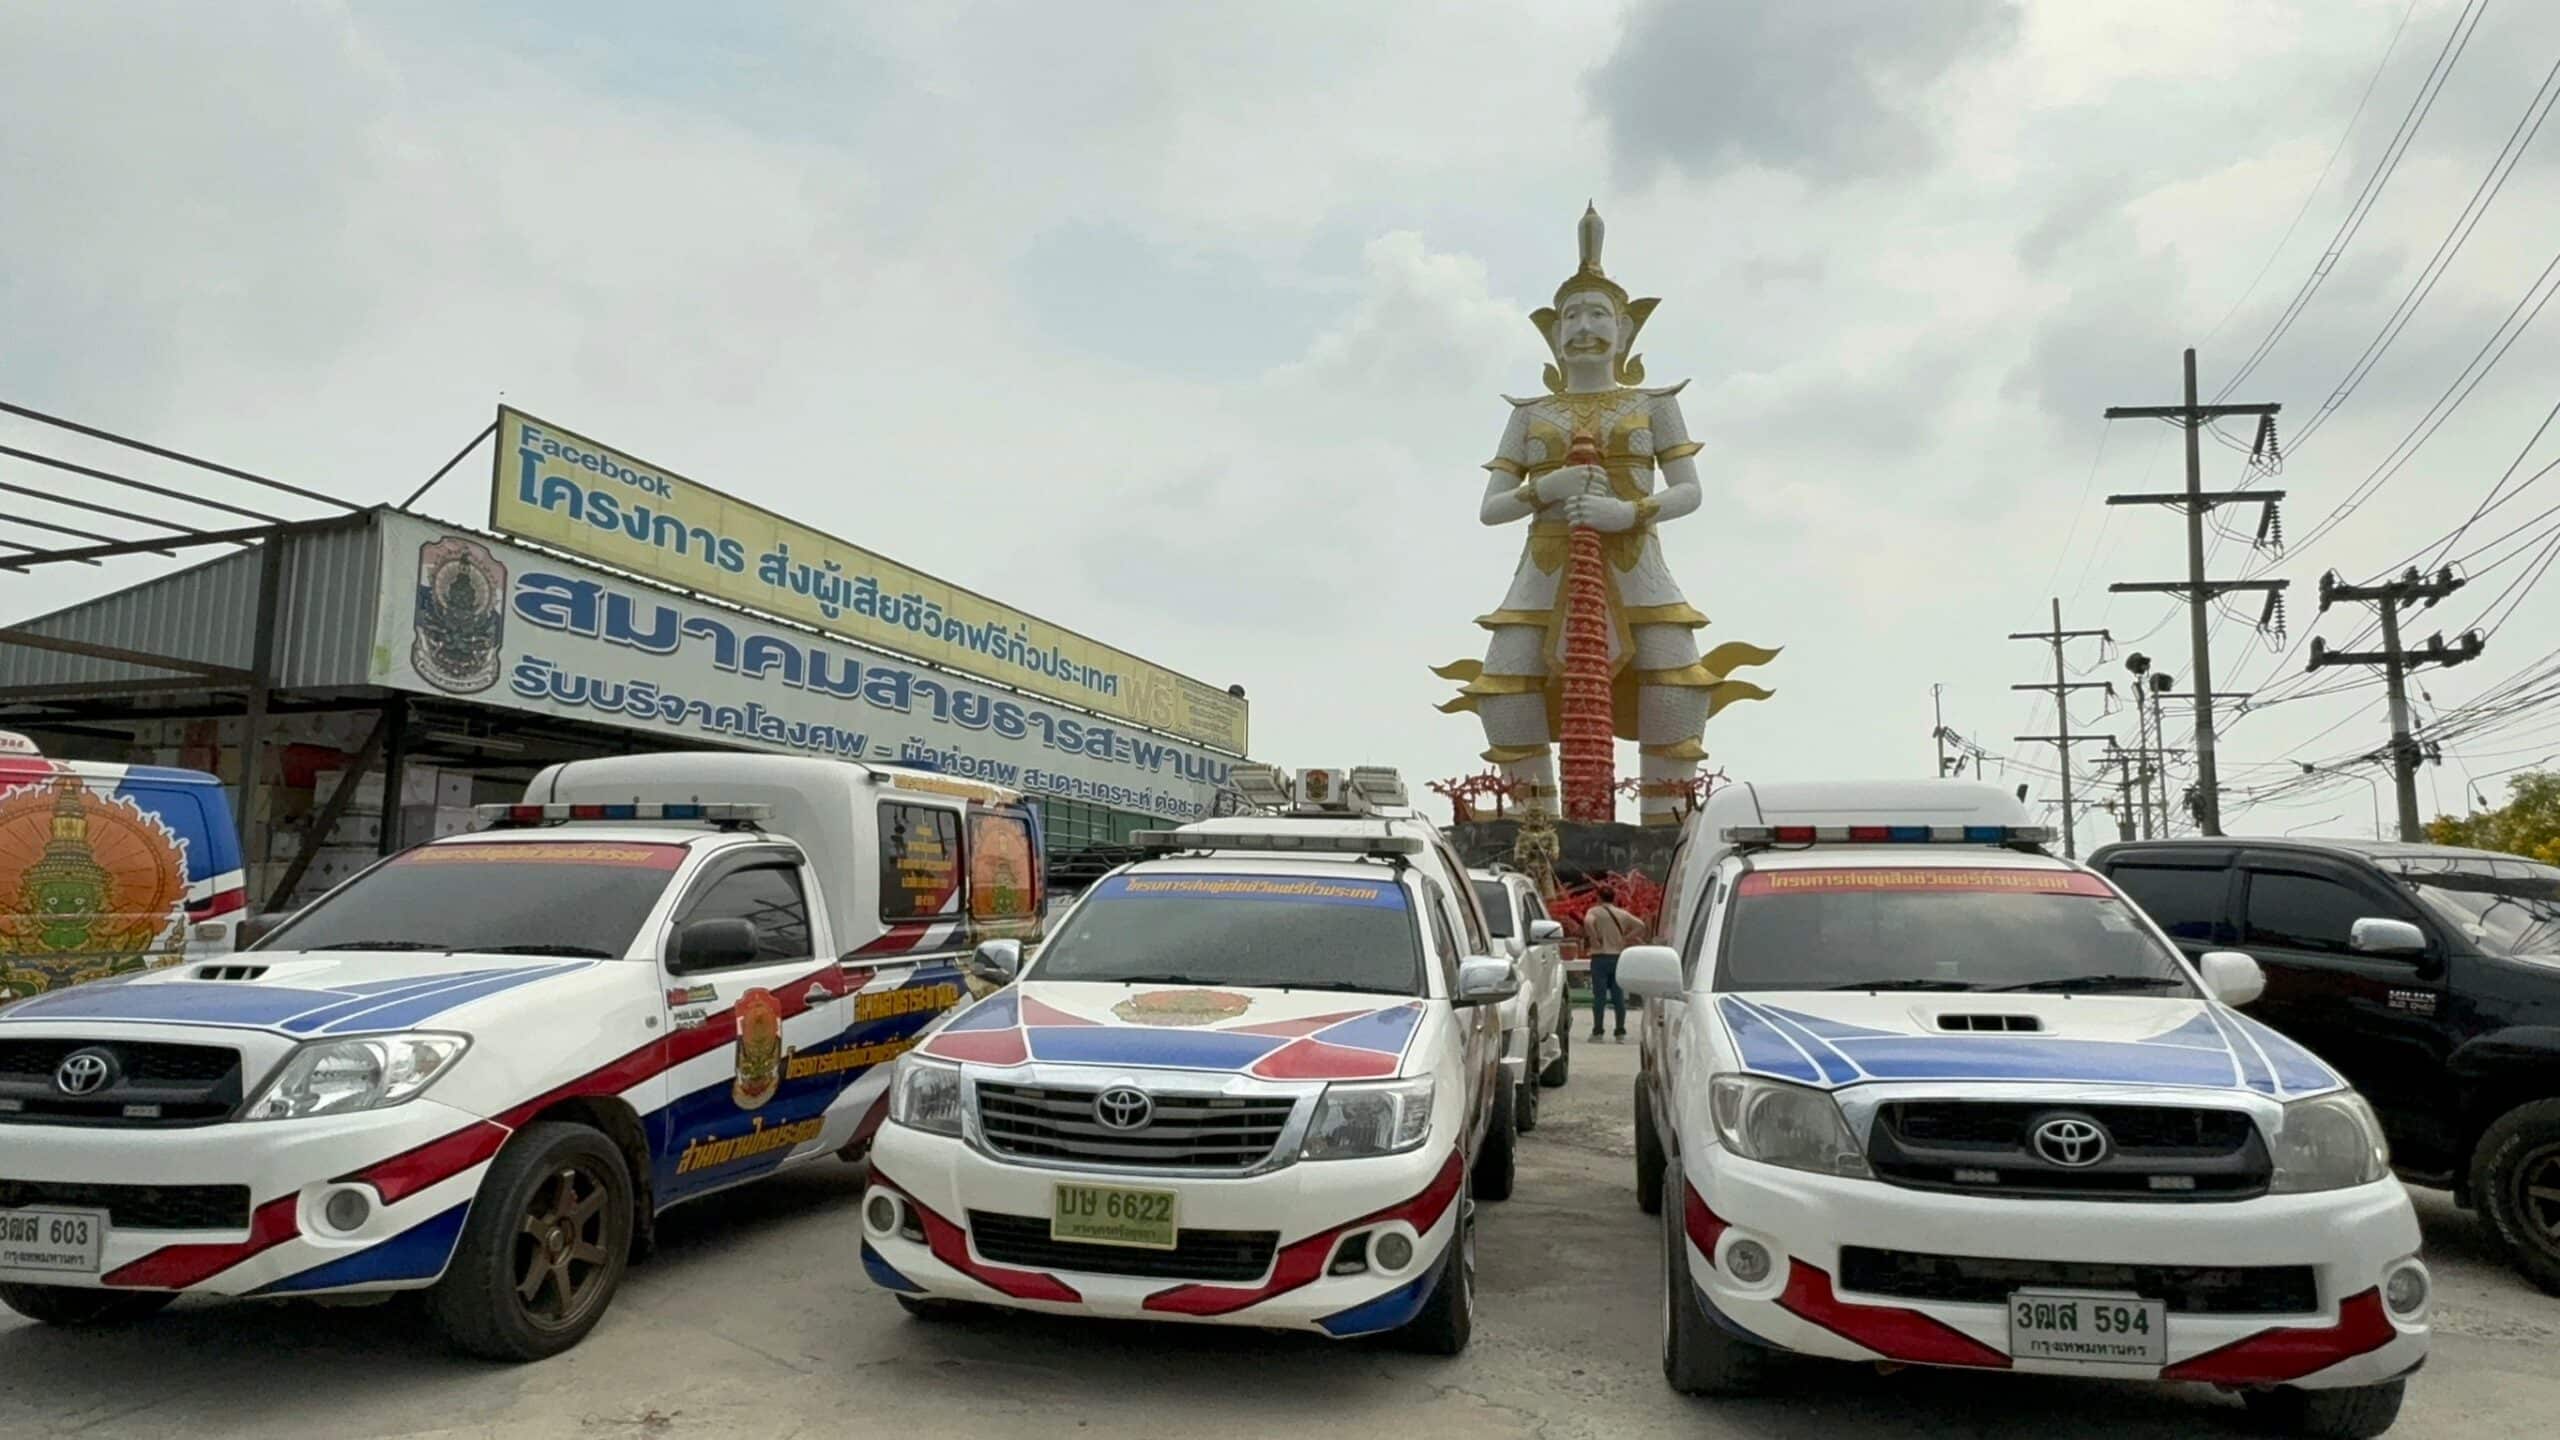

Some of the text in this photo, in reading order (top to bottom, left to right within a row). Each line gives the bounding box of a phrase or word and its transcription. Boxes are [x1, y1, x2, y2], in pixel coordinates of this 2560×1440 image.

[520, 424, 672, 500] Facebook
[518, 446, 745, 573] โครงการ
[758, 543, 1118, 697] ส่งผู้เสียชีวิตฟรีทั่วประเทศ
[511, 655, 866, 755] รับบริจาคโลงศพ
[1107, 1192, 1170, 1223] 6622
[51, 1219, 88, 1245] 603
[2095, 1306, 2149, 1335] 594
[2031, 1339, 2147, 1357] กรุงเทพมหานคร
